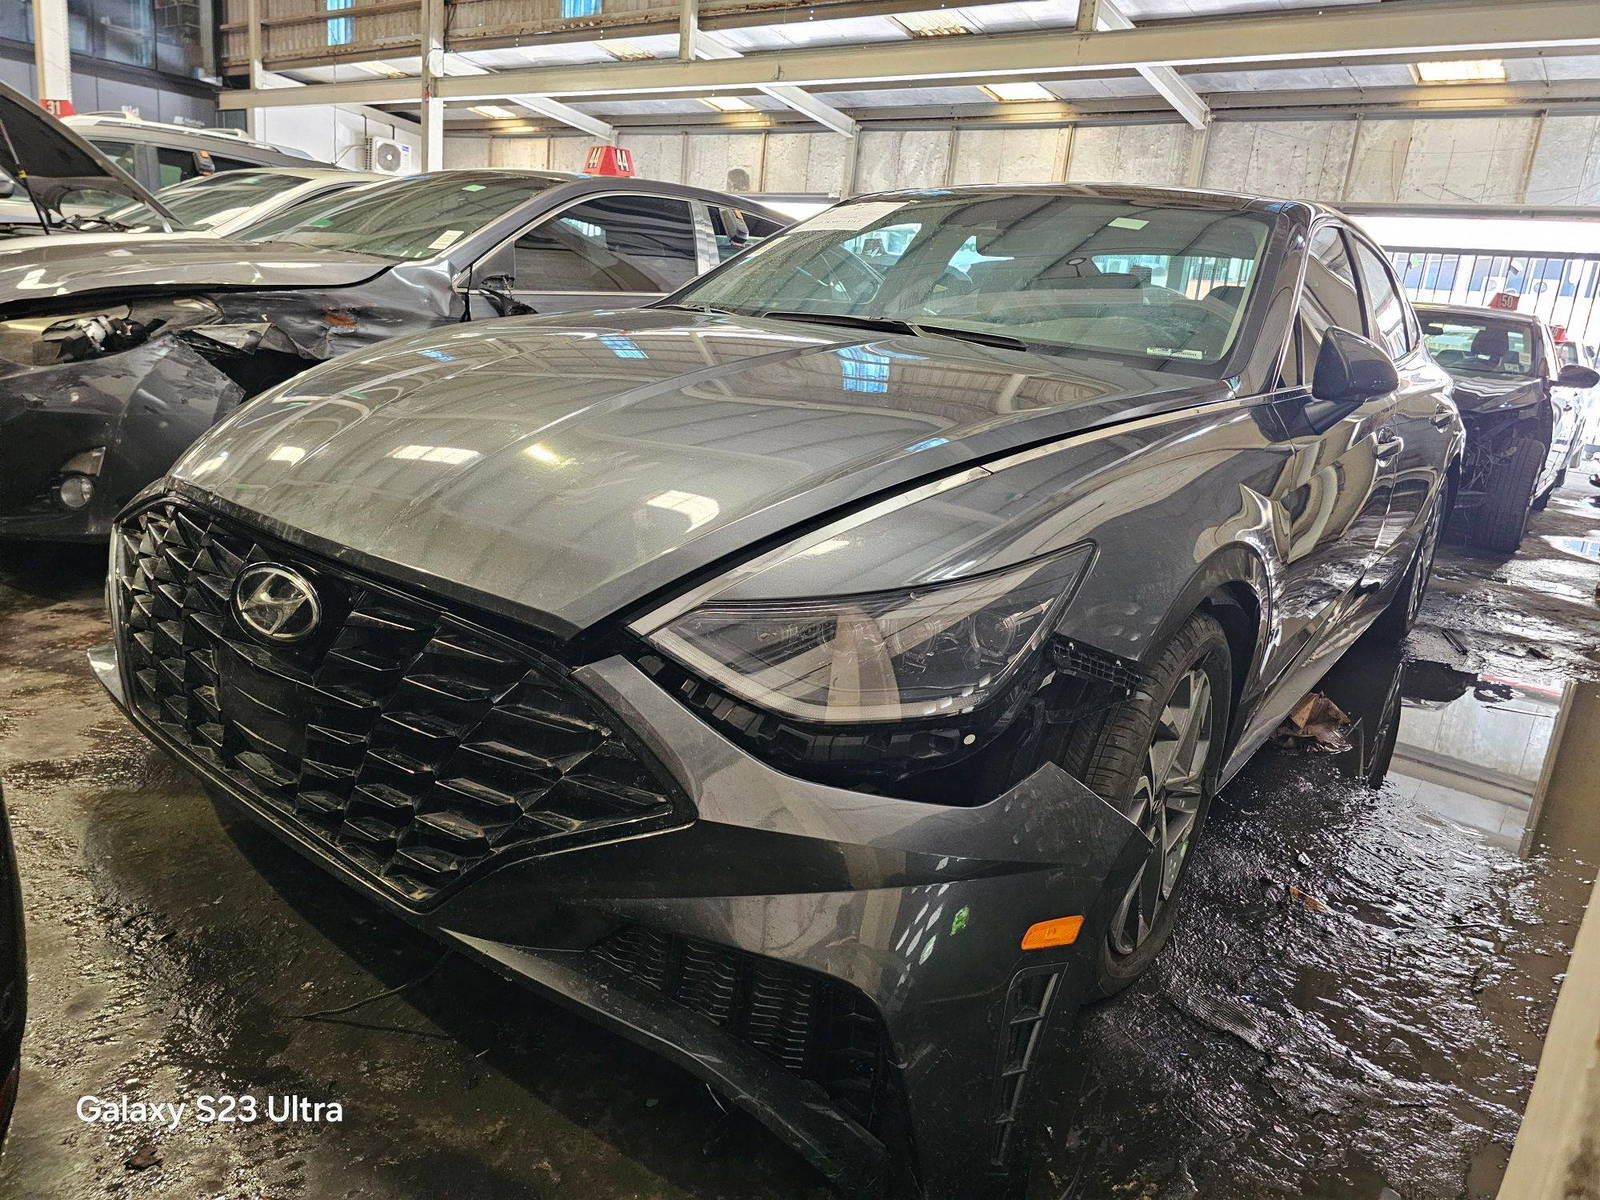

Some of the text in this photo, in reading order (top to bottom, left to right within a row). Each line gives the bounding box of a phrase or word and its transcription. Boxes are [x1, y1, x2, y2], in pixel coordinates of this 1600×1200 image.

[47, 100, 62, 115] 31
[615, 149, 630, 172] 44
[1501, 295, 1514, 308] 50
